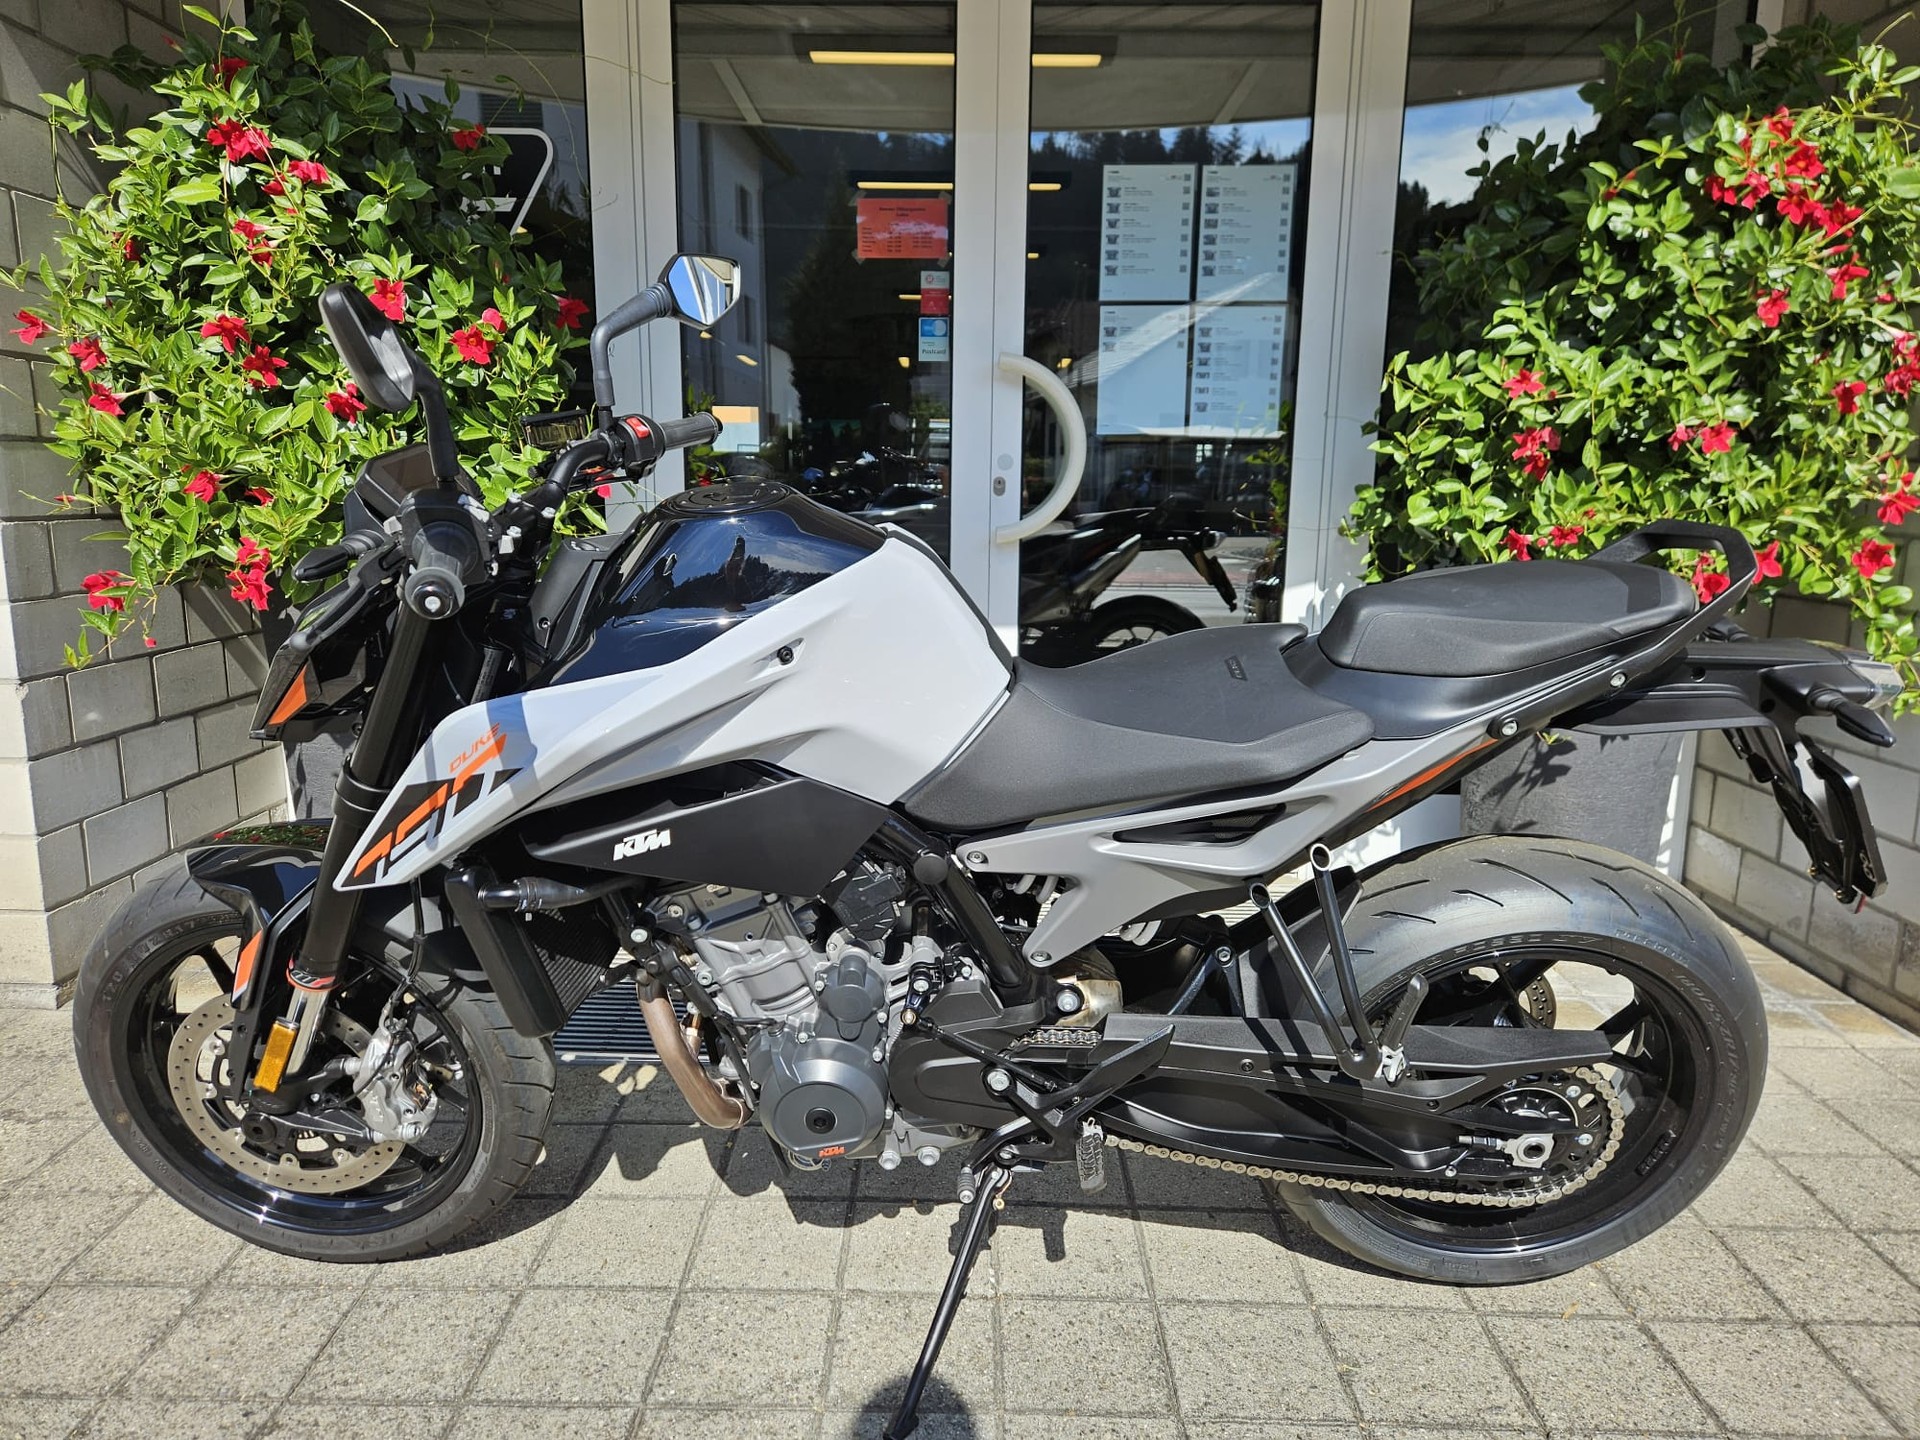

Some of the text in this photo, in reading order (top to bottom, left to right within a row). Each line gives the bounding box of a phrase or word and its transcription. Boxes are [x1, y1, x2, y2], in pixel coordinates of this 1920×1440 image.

[449, 722, 500, 774] DUKE
[612, 829, 671, 861] KTM
[818, 1146, 845, 1158] KTM
